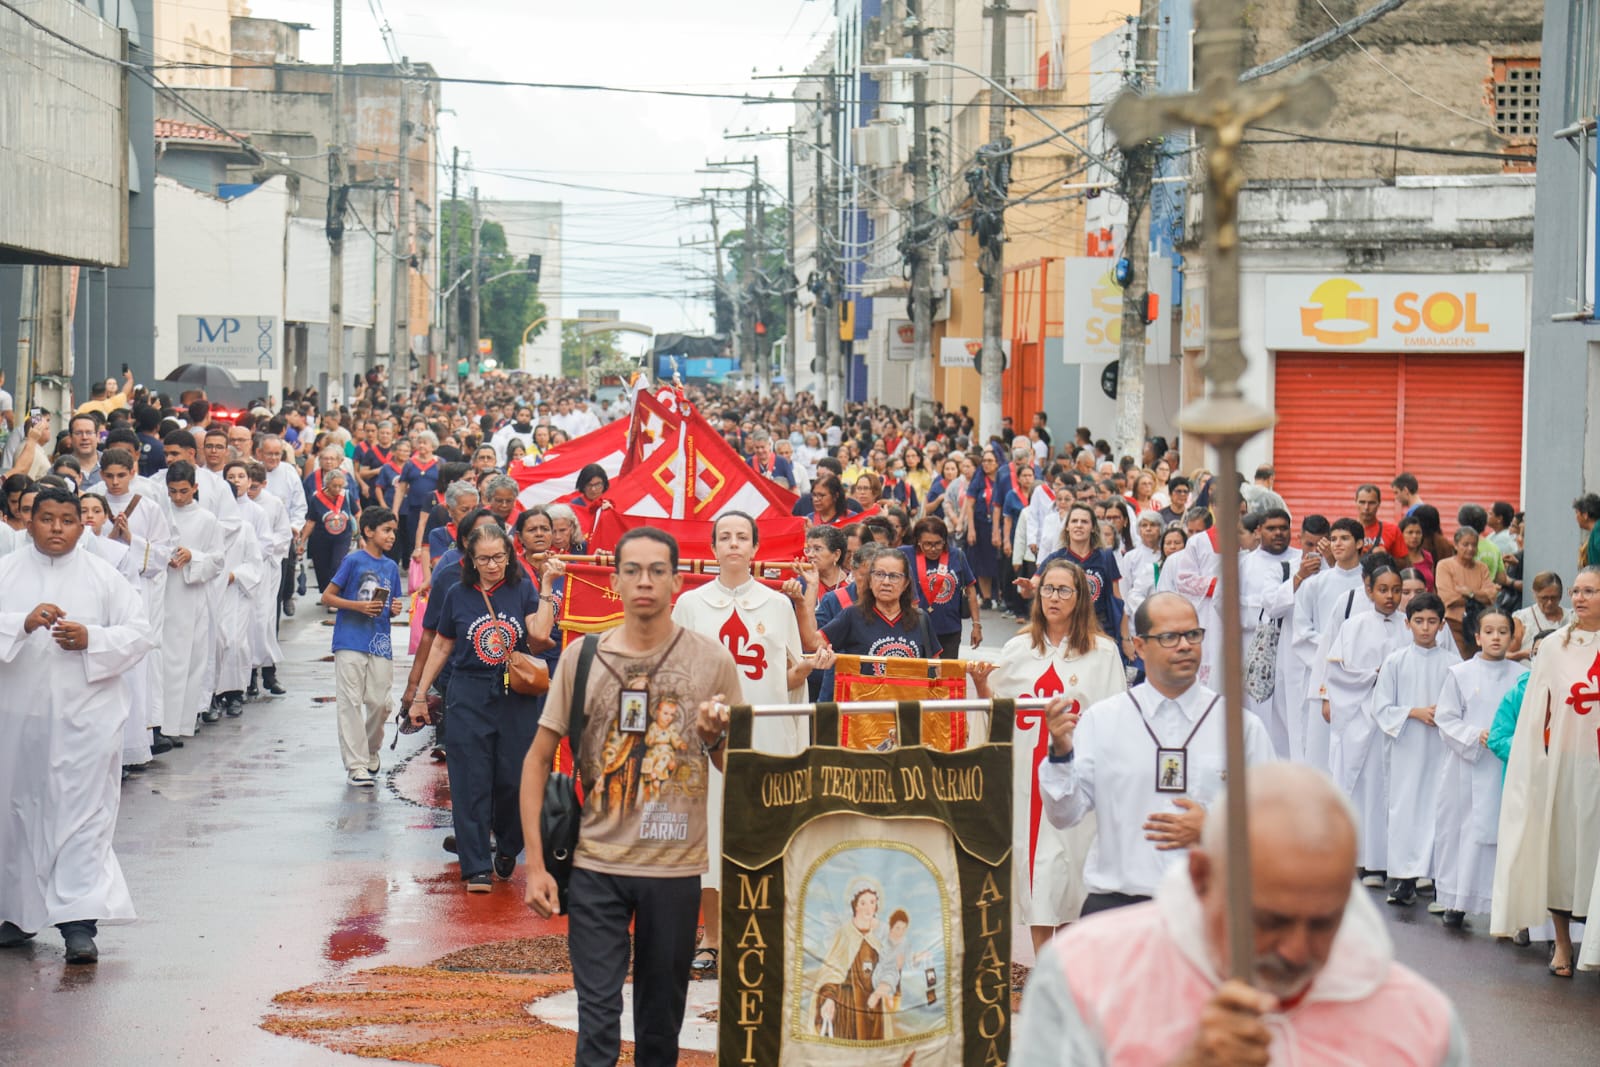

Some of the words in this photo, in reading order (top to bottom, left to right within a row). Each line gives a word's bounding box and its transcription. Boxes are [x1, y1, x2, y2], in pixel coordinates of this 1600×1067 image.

[195, 316, 241, 343] MP
[1085, 316, 1152, 346] SO
[1391, 291, 1490, 335] SOL
[1404, 337, 1476, 346] EMBALAGENS
[762, 766, 812, 807] ORDEM
[820, 765, 896, 804] TERCEIRA
[899, 765, 926, 801] DO
[932, 765, 984, 802] CARMO
[639, 822, 688, 840] CARMO
[736, 873, 773, 1067] MACEI
[974, 871, 1008, 1067] ALAGOA
